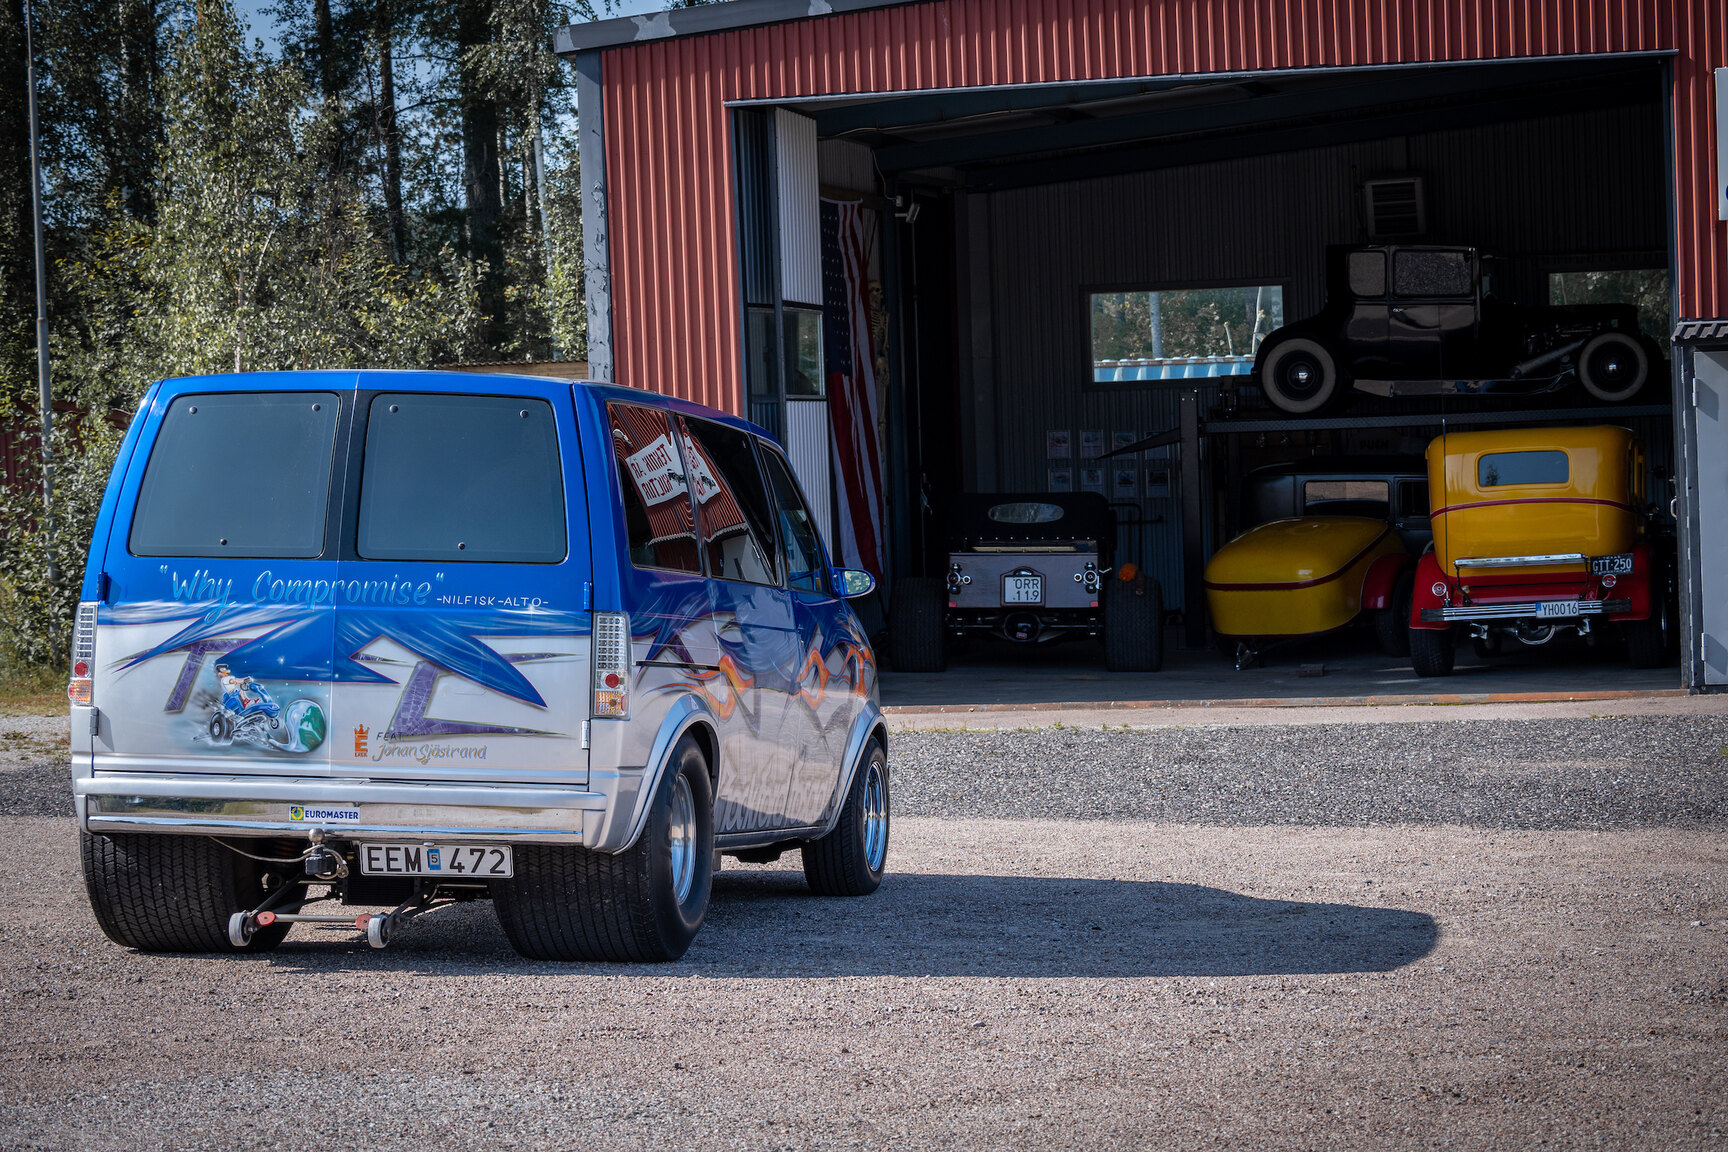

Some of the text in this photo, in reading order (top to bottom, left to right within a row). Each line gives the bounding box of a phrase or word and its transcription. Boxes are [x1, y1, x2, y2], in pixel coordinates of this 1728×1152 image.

[1015, 578, 1039, 589] ORR
[372, 743, 488, 765] Johan Sjöstrand
[305, 809, 359, 820] EUROMASTER
[367, 846, 422, 873] EEM
[450, 848, 506, 874] 472
